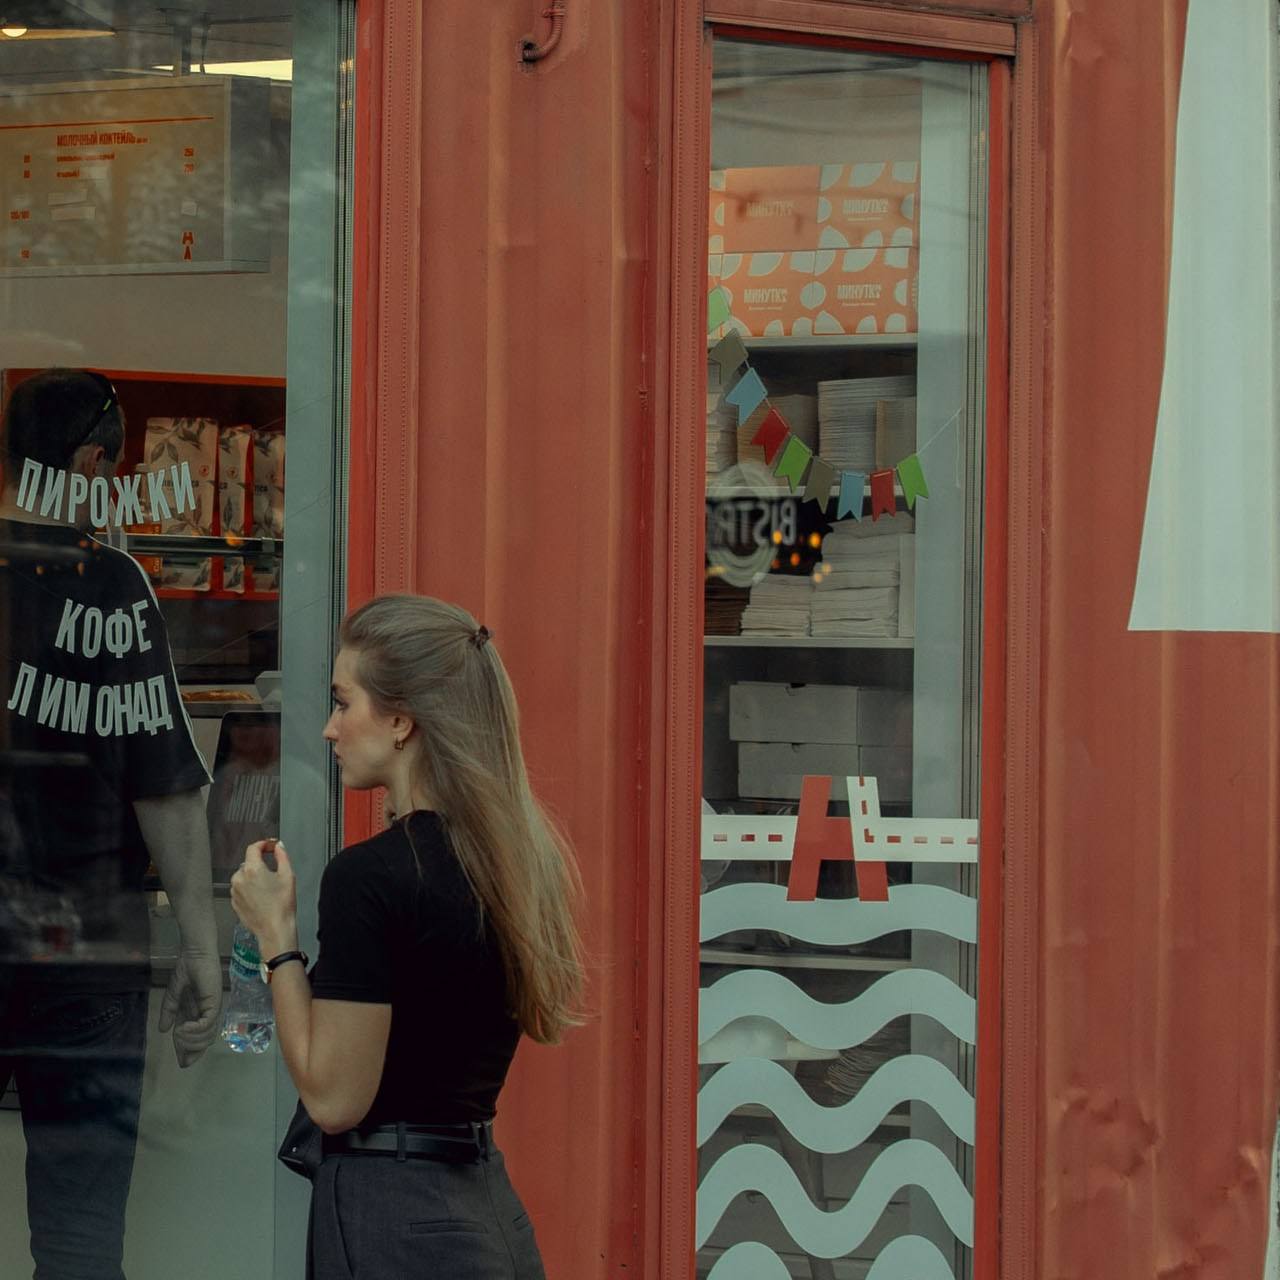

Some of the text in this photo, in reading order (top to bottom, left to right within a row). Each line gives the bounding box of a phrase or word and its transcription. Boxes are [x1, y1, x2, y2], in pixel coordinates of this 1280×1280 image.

[16, 456, 197, 528] ПИРОЖКИ
[54, 597, 153, 659] КОФЕ
[6, 661, 174, 737] ЛИМОНАД
